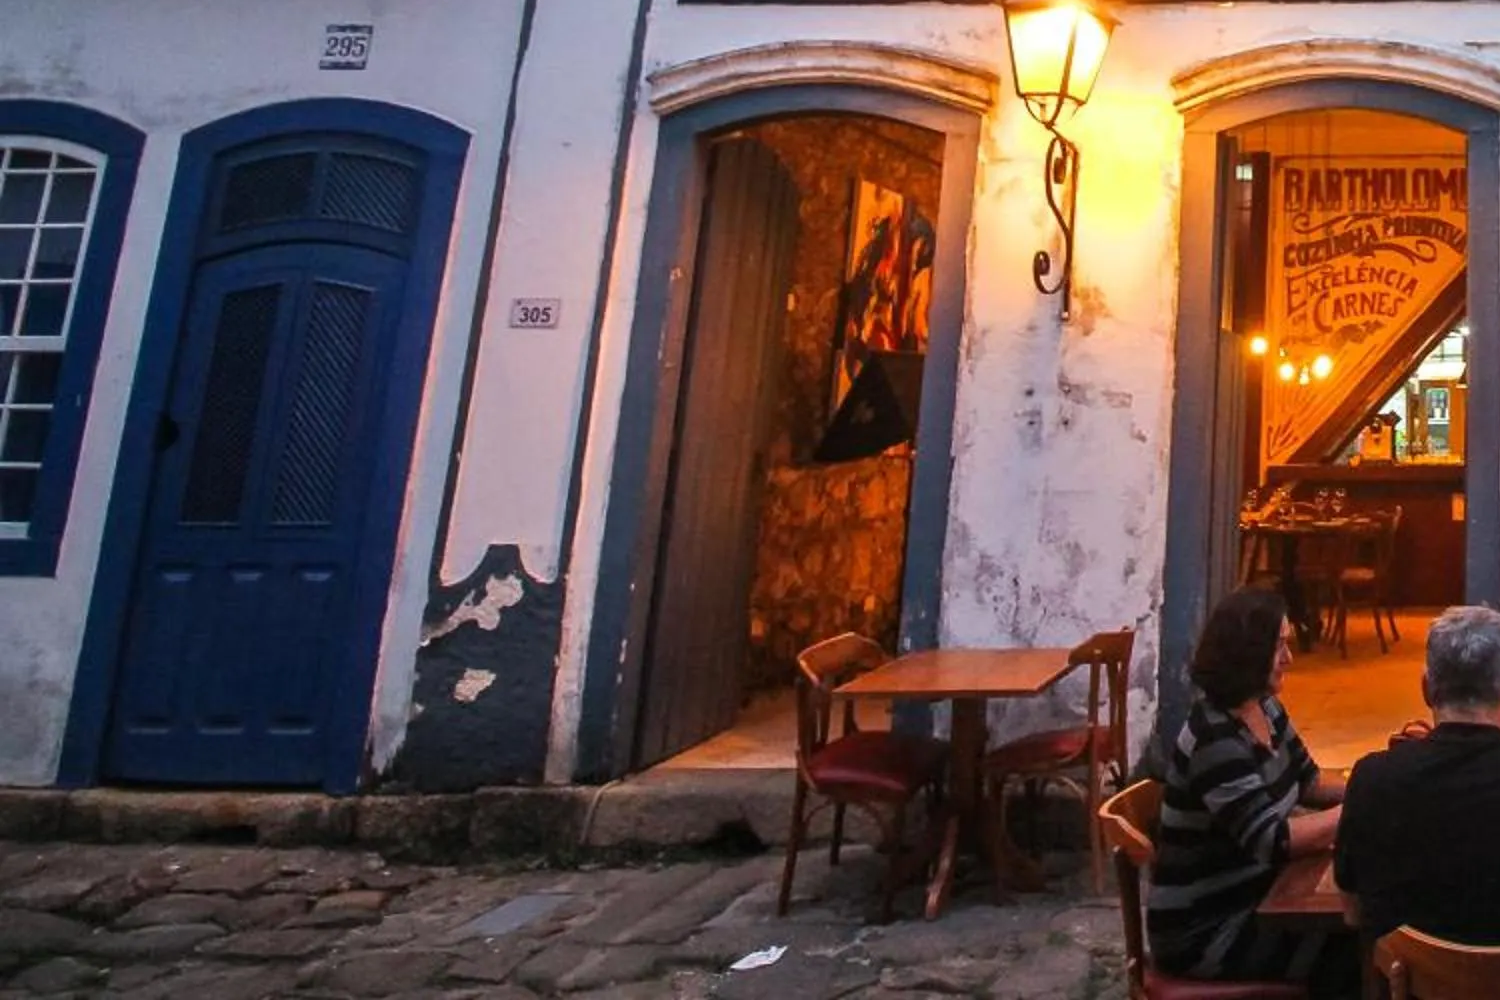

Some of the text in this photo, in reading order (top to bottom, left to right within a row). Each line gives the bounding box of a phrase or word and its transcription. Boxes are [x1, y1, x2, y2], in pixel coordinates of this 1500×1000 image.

[325, 35, 367, 57] 295
[519, 306, 552, 323] 305
[1313, 291, 1406, 333] CARNES
